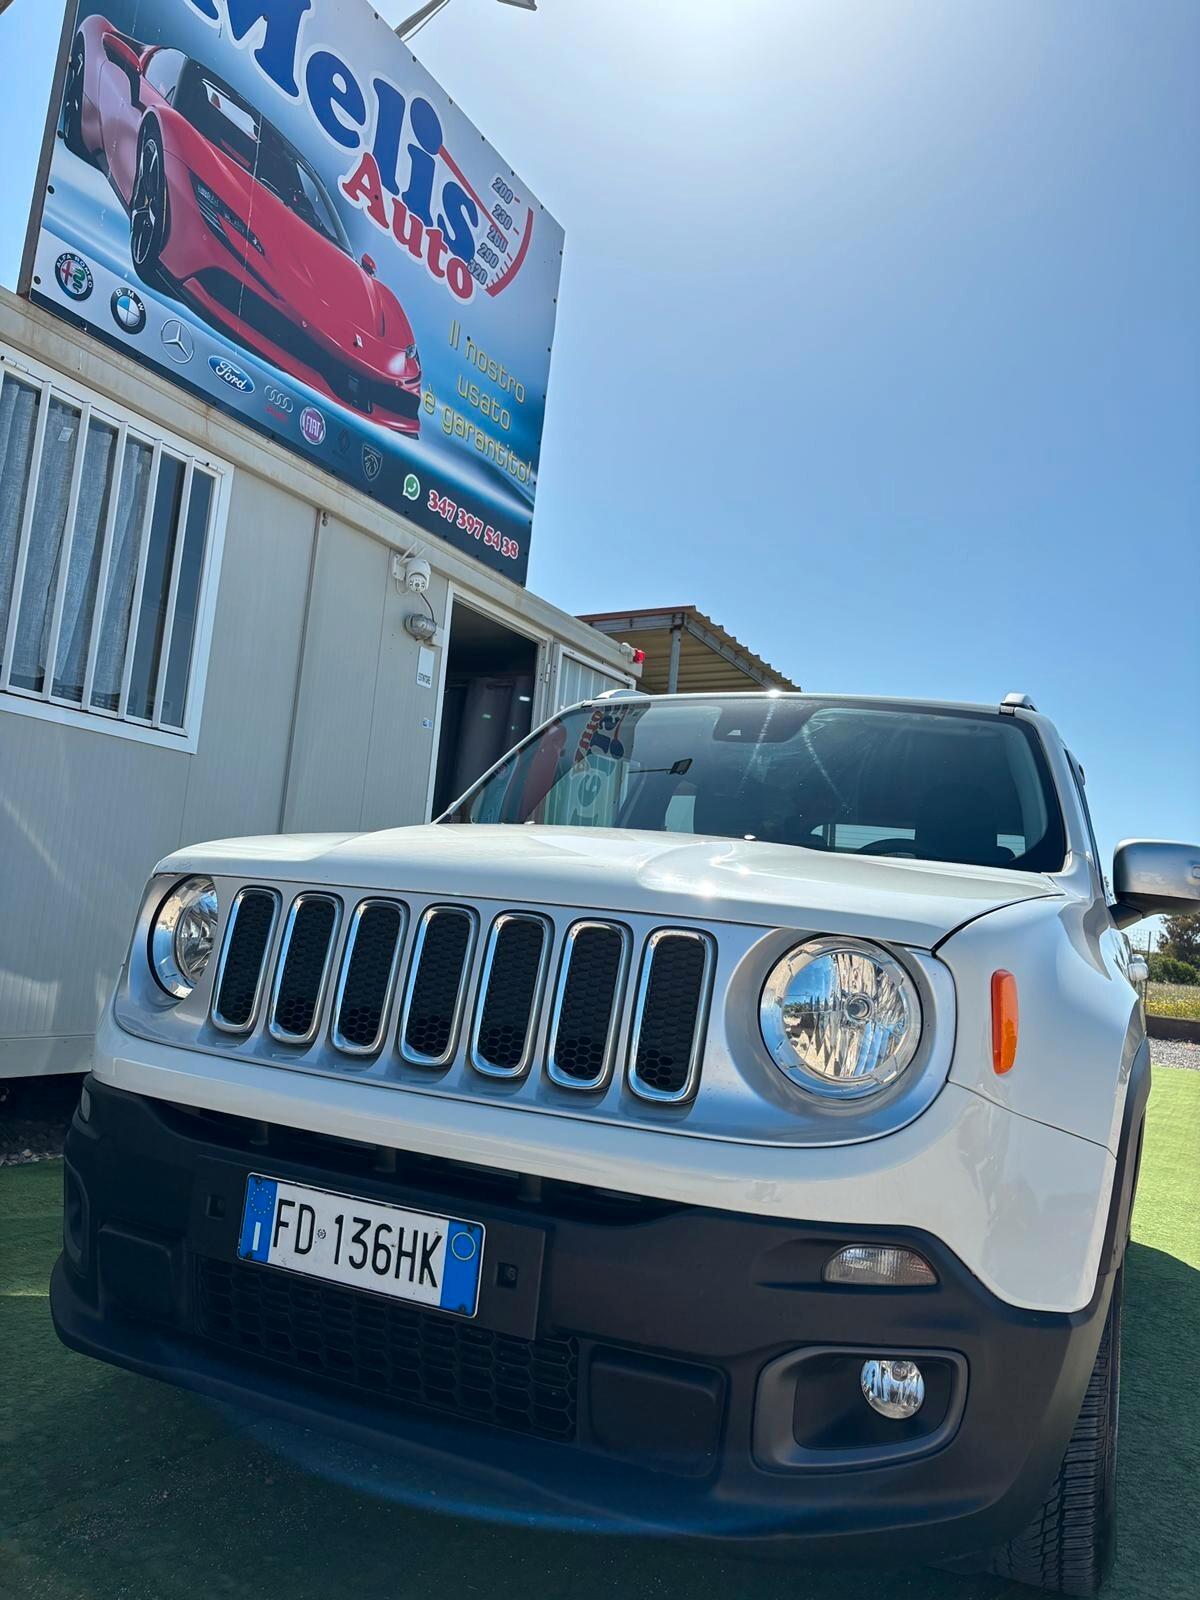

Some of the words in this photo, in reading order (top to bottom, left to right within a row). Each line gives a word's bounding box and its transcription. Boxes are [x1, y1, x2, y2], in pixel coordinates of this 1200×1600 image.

[491, 176, 514, 205] 200
[342, 152, 474, 300] Auto
[491, 203, 513, 231] 230
[56, 254, 72, 268] ALFA
[74, 256, 93, 289] ROMEO
[467, 257, 488, 286] 320
[477, 242, 499, 269] 290
[115, 288, 145, 312] BMW
[215, 360, 246, 390] Ford
[449, 319, 460, 350] Il
[465, 339, 526, 404] nostro
[456, 374, 511, 431] usato
[304, 415, 323, 437] FIAT
[422, 384, 436, 415] è
[440, 404, 532, 486] garantito!
[428, 490, 456, 523] 347
[457, 508, 483, 539] 397
[484, 526, 502, 551] 54
[500, 536, 519, 559] 38
[272, 1198, 316, 1255] FD
[334, 1214, 442, 1288] 136HK
